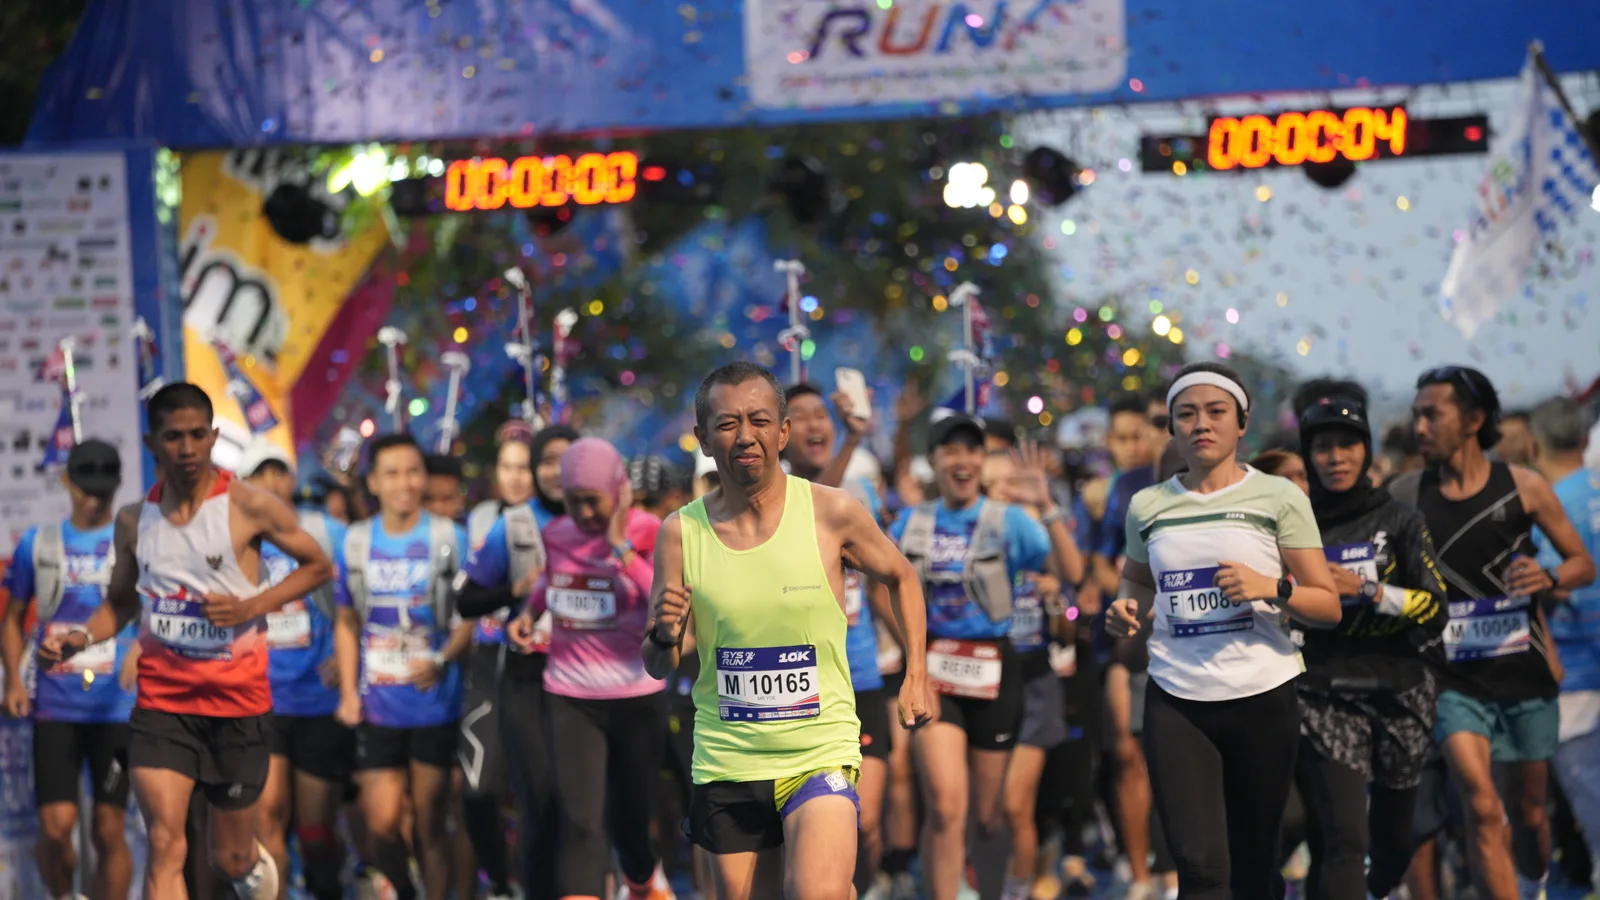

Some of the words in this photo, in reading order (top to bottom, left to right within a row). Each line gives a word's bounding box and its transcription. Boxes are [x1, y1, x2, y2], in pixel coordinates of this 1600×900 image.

[808, 0, 1002, 60] RUN
[1208, 106, 1407, 170] 00:00:04
[1169, 595, 1179, 613] F
[157, 619, 171, 638] M
[1450, 623, 1465, 641] M
[721, 651, 744, 659] SYS
[779, 651, 810, 663] 10K
[722, 658, 744, 666] RUN
[724, 674, 740, 695] M
[749, 672, 810, 695] 10165
